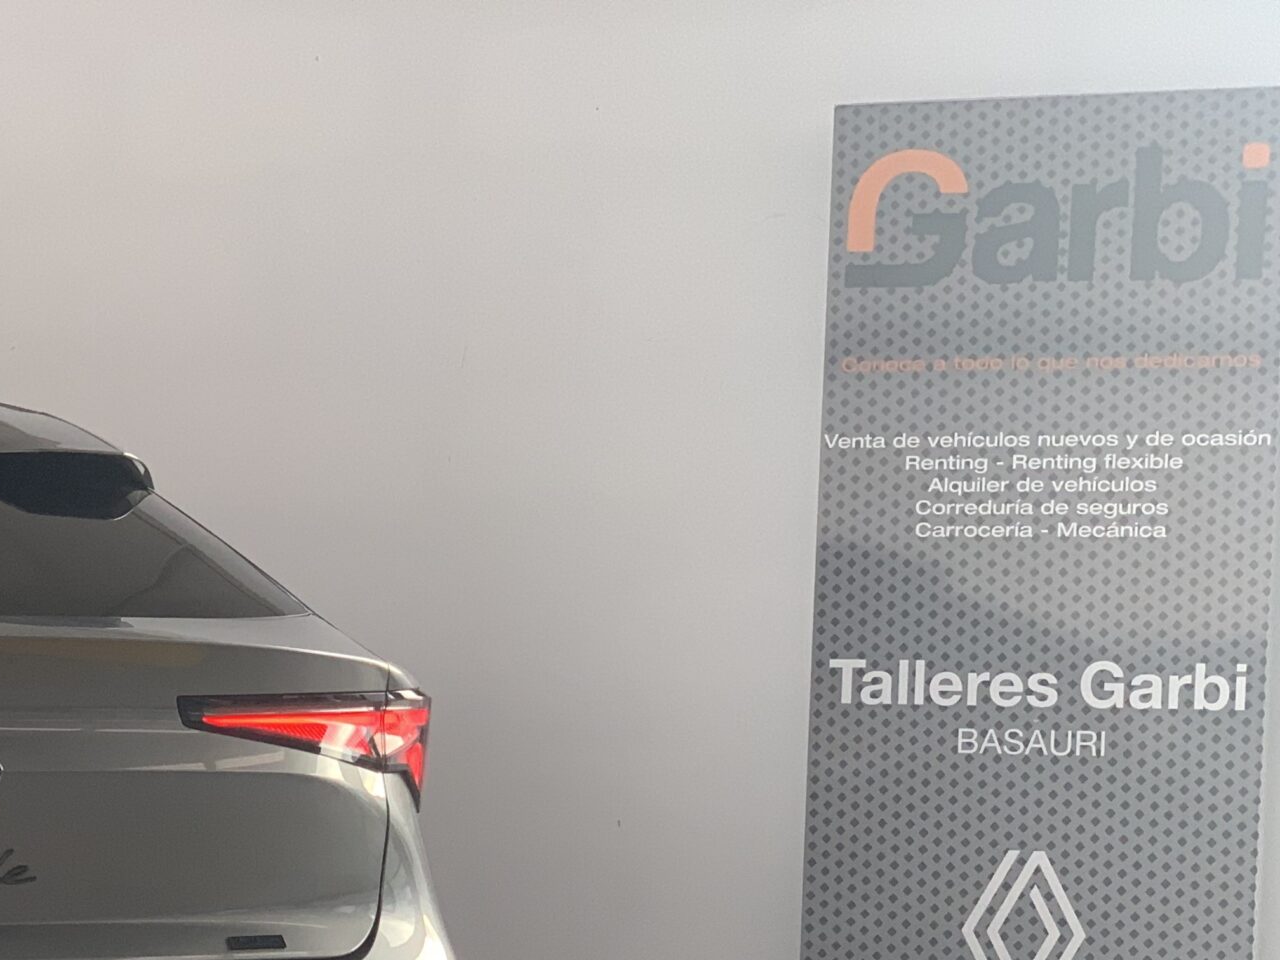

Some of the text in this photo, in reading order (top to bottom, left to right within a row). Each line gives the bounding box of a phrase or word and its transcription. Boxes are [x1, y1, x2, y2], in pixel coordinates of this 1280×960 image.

[844, 142, 1271, 288] Garbi
[933, 359, 946, 371] a
[1011, 355, 1030, 370] lo
[1037, 356, 1078, 372] que
[1086, 356, 1126, 370] nos
[1134, 352, 1263, 369] dedicamos
[824, 429, 1271, 449] Venta de vehículos nuevos y de ocasión
[905, 455, 988, 474] Renting
[1012, 453, 1097, 473] Renting
[1104, 453, 1184, 470] flexible
[927, 476, 1157, 496] Alquiler de vehículos
[915, 499, 1169, 518] Correduría de seguros
[915, 521, 1033, 538] Carrocería
[1057, 521, 1167, 538] Mecánica
[829, 658, 1248, 711] Talleres Garbi
[957, 727, 1107, 757] BASAURI
